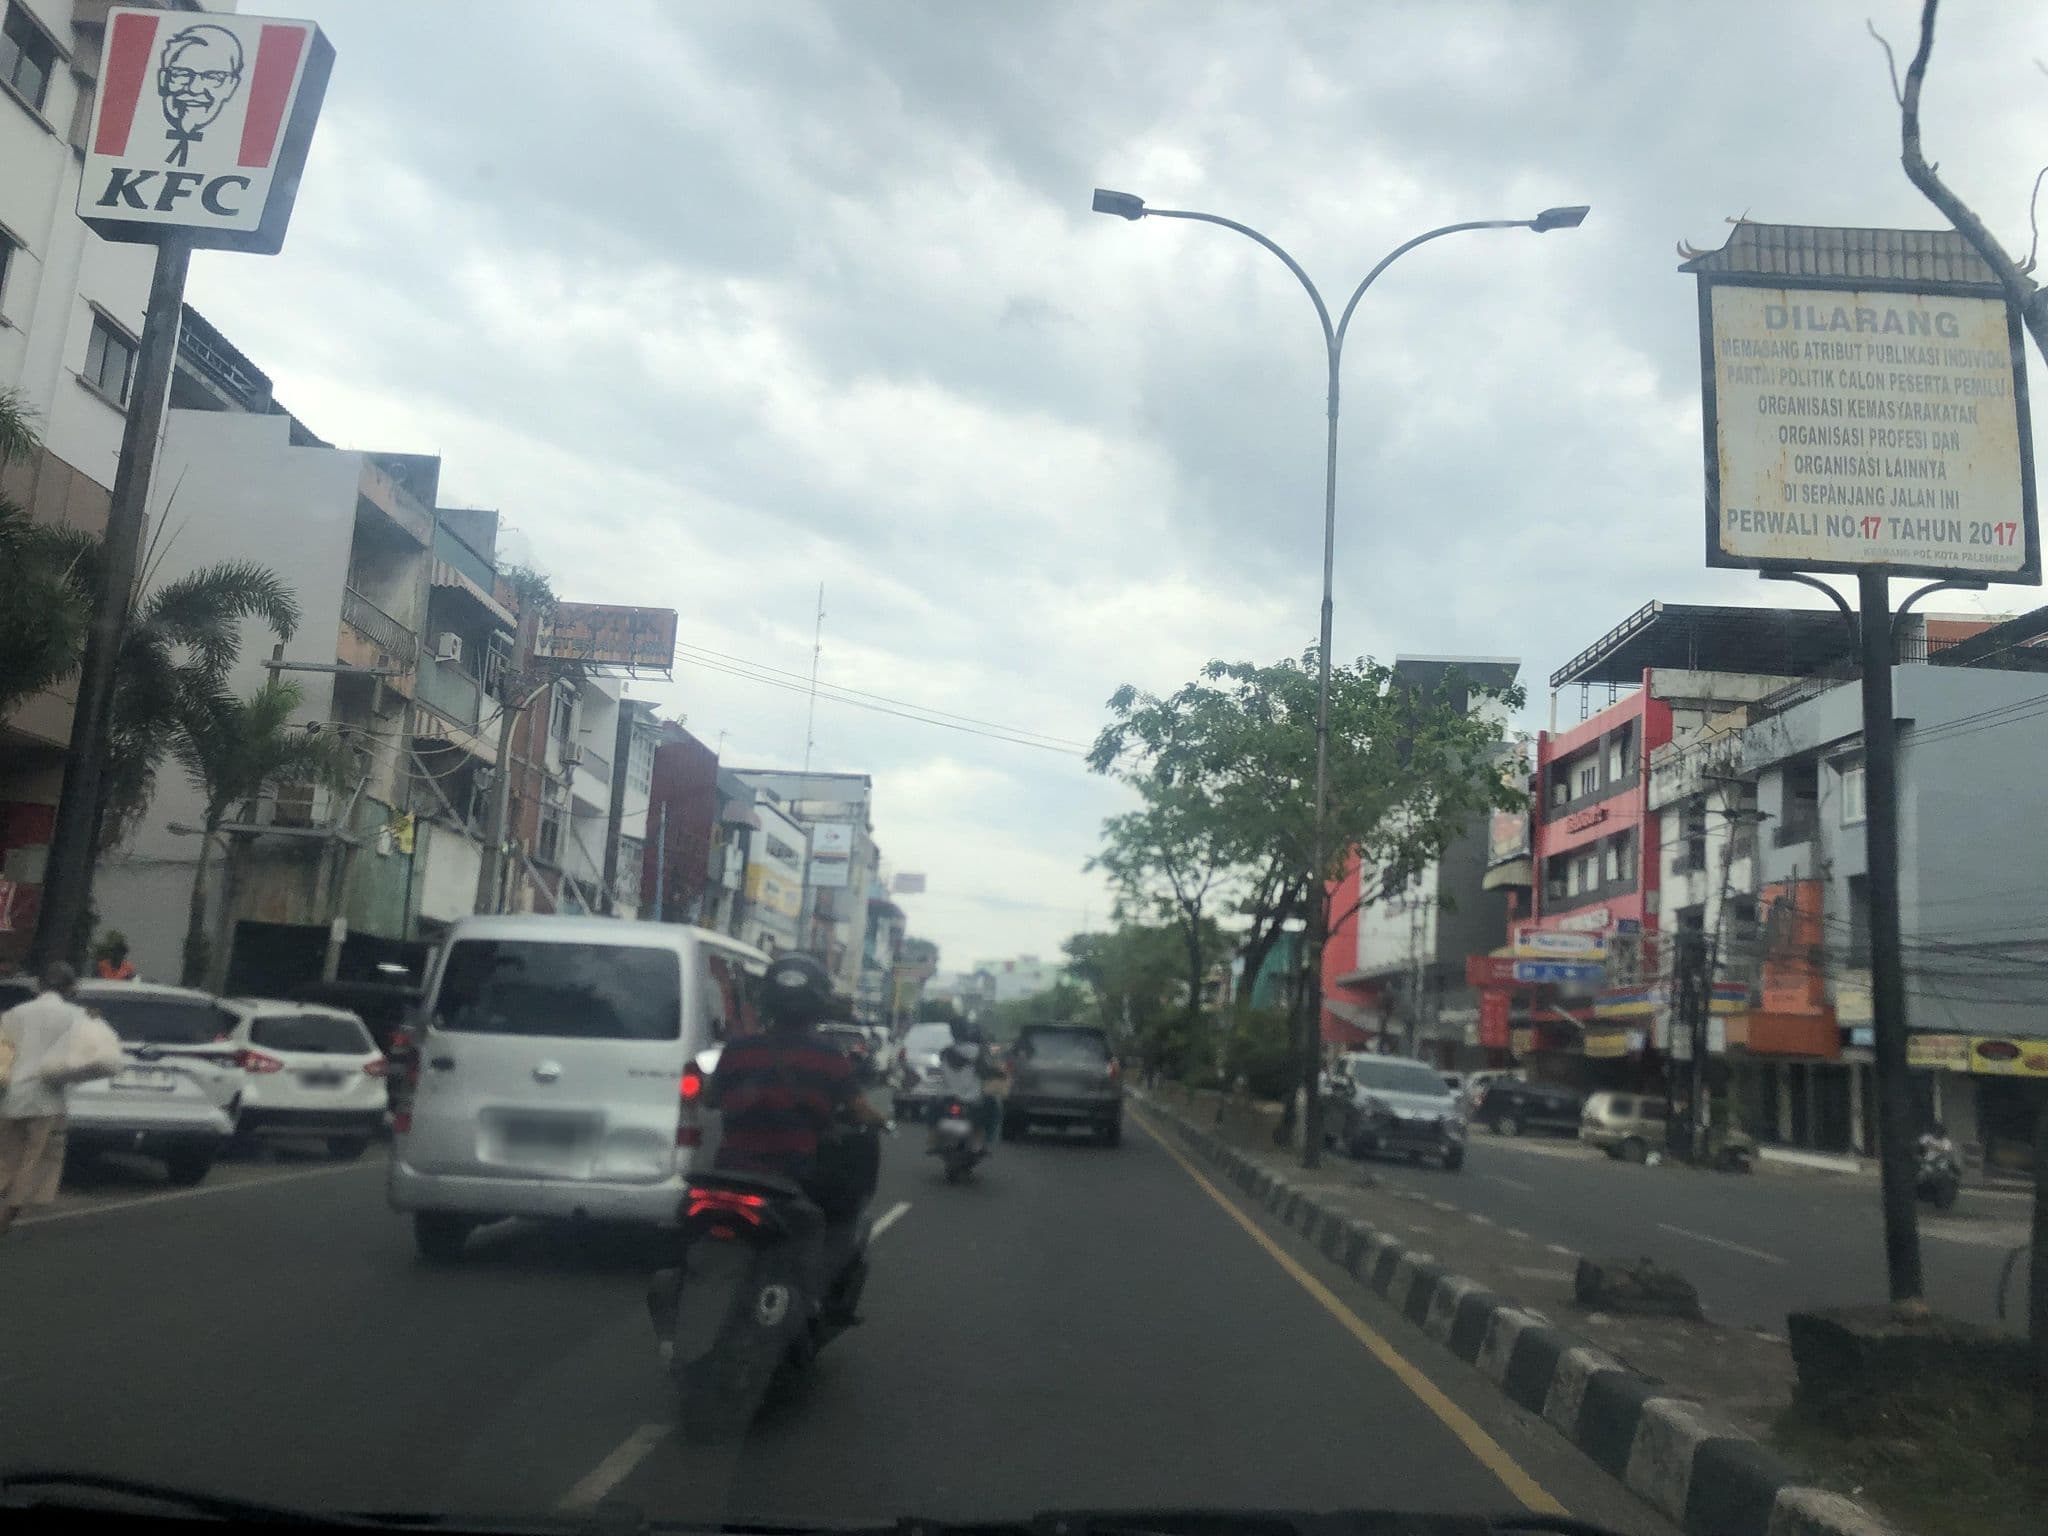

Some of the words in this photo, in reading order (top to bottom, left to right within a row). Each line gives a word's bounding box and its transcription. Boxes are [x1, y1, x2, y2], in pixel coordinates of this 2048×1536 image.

[96, 167, 251, 216] KFC
[1765, 304, 1960, 338] DILARANG
[1721, 338, 1799, 360] MEMASANG
[1804, 341, 1863, 361] ATRIBUT
[1867, 344, 1939, 366] PUBLIKASI
[1727, 365, 1776, 385] PARTAI
[1780, 368, 1834, 388] POLITIK
[1839, 369, 1885, 391] CALON
[1890, 373, 1951, 394] PESERTA
[1954, 377, 2006, 397] PEMILU
[1758, 395, 1842, 417] ORGANISASI
[1847, 399, 1977, 425] KEMASYARAKATAN
[1778, 425, 1864, 447] ORGANISASI
[1869, 428, 1928, 449] PROFESI
[1932, 430, 1960, 452] DAN
[1794, 454, 1880, 477] ORGANISASI
[1885, 458, 1947, 480] LAINNYA
[1784, 484, 1797, 503] DI
[1802, 485, 1885, 506] SEPANJANG
[1890, 487, 1936, 508] JALAN
[1940, 489, 1960, 510] INI
[1727, 508, 1818, 536] PERWALI
[1888, 518, 1962, 543] TAHUN
[1968, 520, 2017, 546] 2017
[1934, 550, 1960, 561] KOTA
